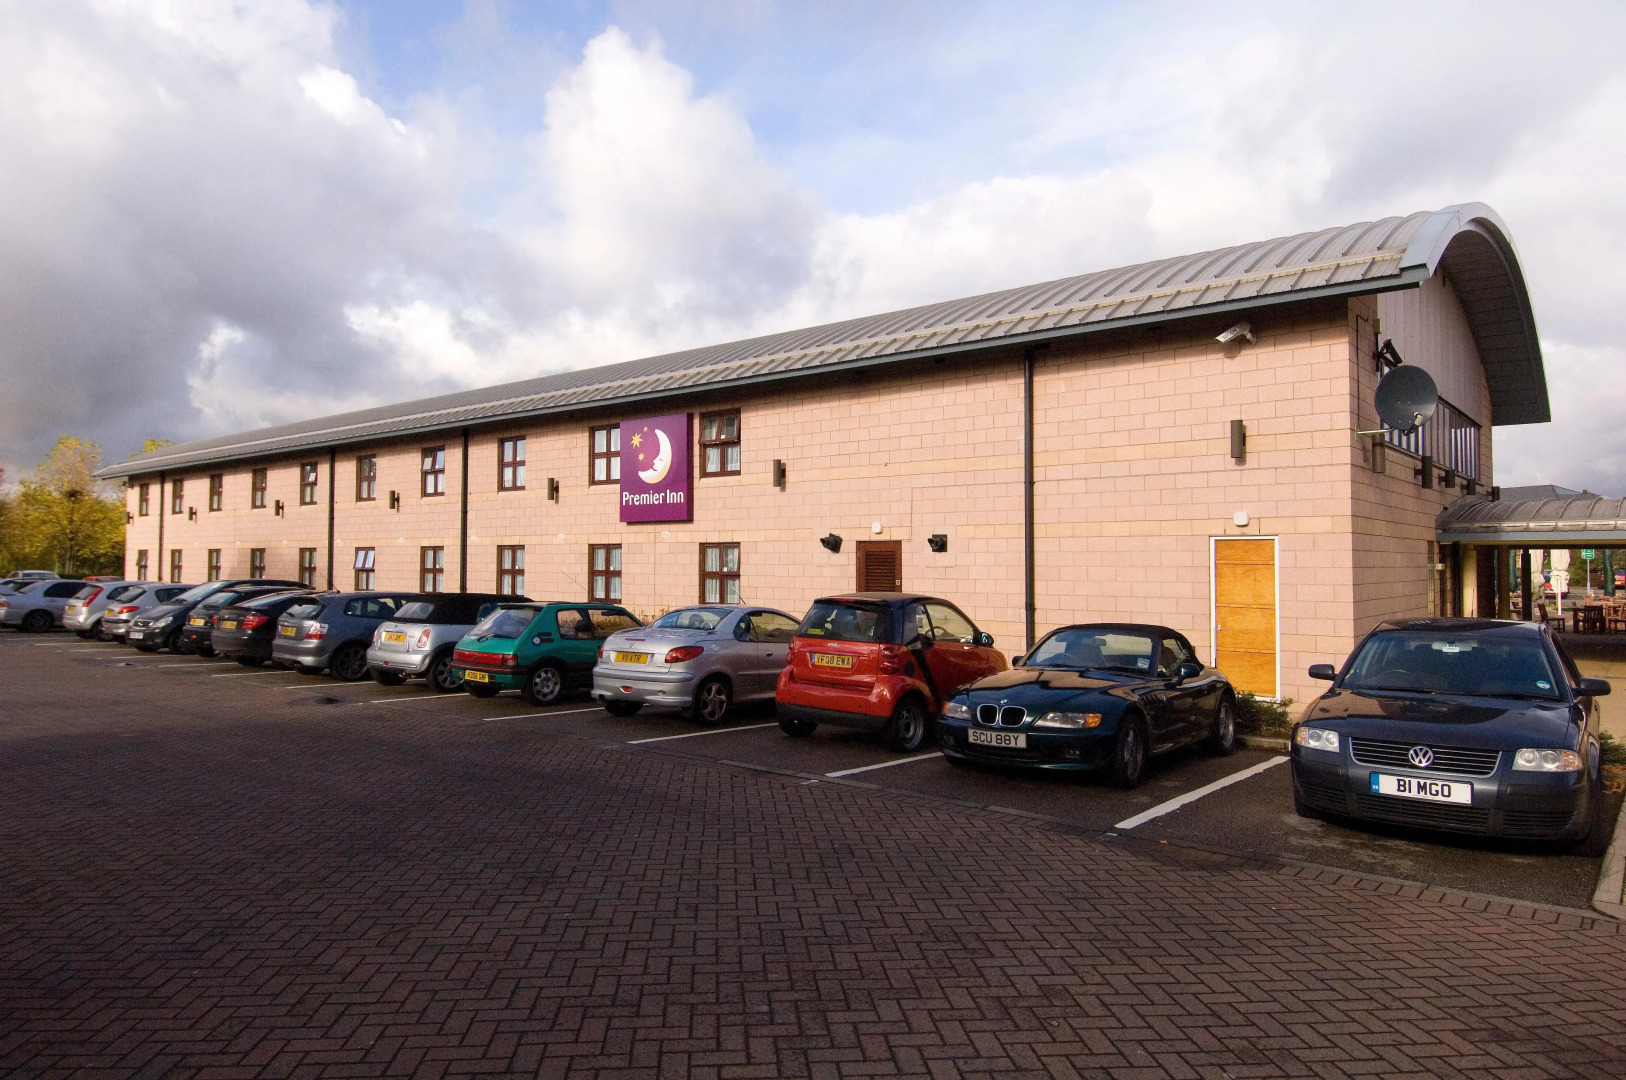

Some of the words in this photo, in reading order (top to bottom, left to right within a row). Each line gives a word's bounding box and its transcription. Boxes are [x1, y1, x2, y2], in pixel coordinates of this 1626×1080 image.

[622, 490, 665, 506] Premier
[666, 489, 684, 504] Inn
[816, 654, 835, 665] YF08
[972, 731, 992, 744] SCU
[995, 734, 1020, 746] 88Y
[1416, 780, 1452, 798] MGO
